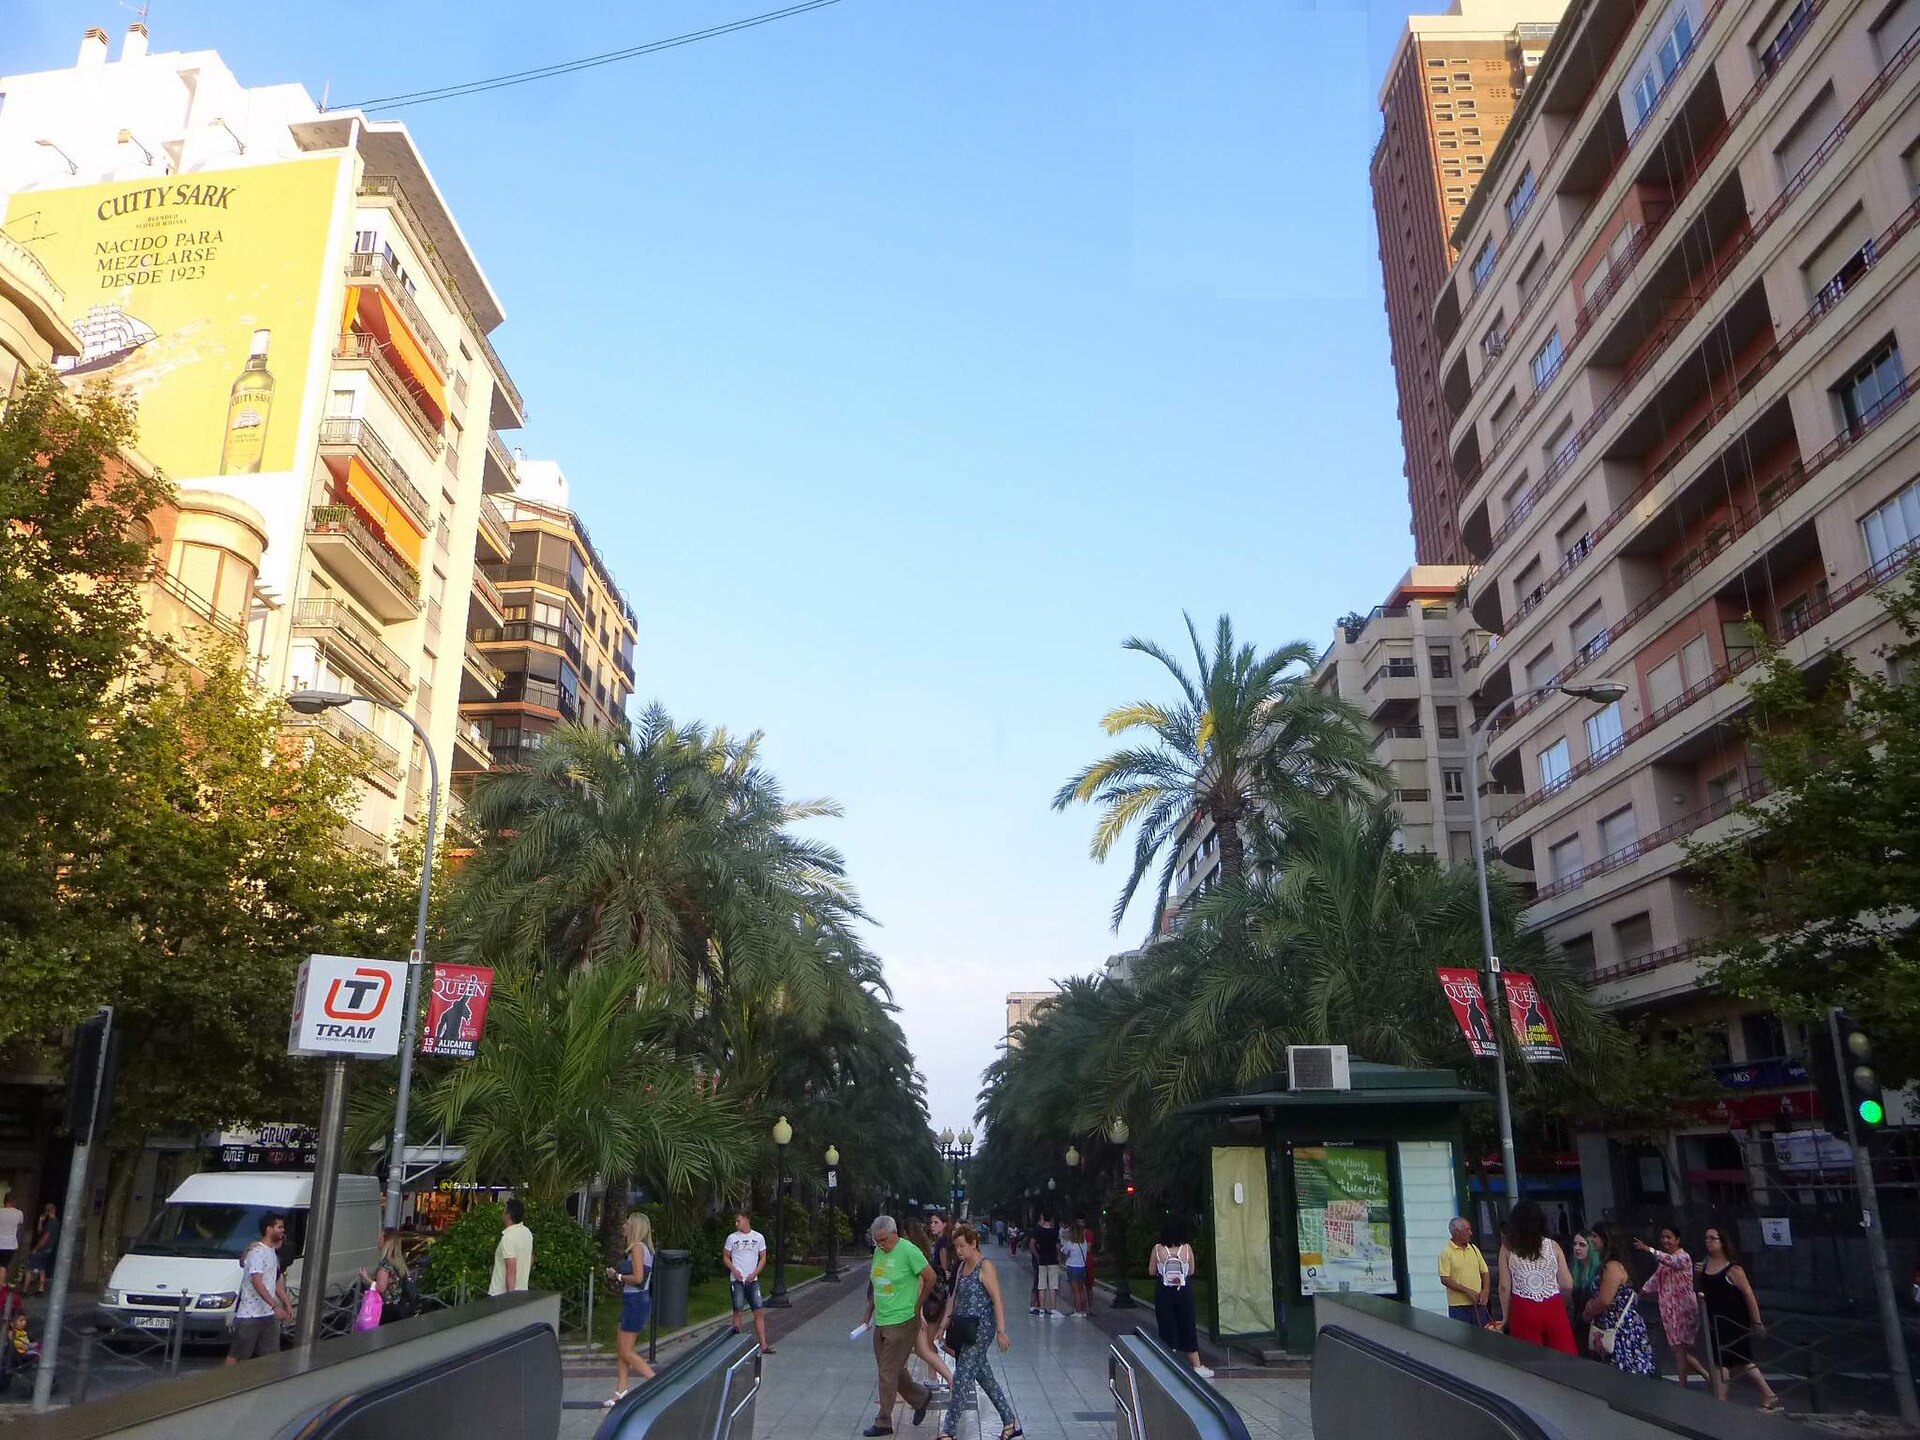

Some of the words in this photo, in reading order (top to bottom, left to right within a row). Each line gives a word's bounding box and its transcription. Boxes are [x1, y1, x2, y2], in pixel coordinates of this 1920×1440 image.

[97, 185, 174, 221] CUTTY
[172, 184, 237, 209] SARK
[94, 235, 168, 255] NACIDO
[175, 229, 224, 247] PARA
[96, 247, 217, 272] MEZCLARSE
[101, 269, 164, 289] DESDE
[170, 265, 206, 282] 1923
[431, 978, 488, 1002] QUEEN
[1444, 982, 1484, 1005] QUEEN
[316, 1023, 376, 1040] TRAM
[424, 1038, 434, 1046] 15
[438, 1039, 473, 1050] ALICANTE
[1733, 1071, 1750, 1083] MGS
[222, 1150, 245, 1162] OUTLET
